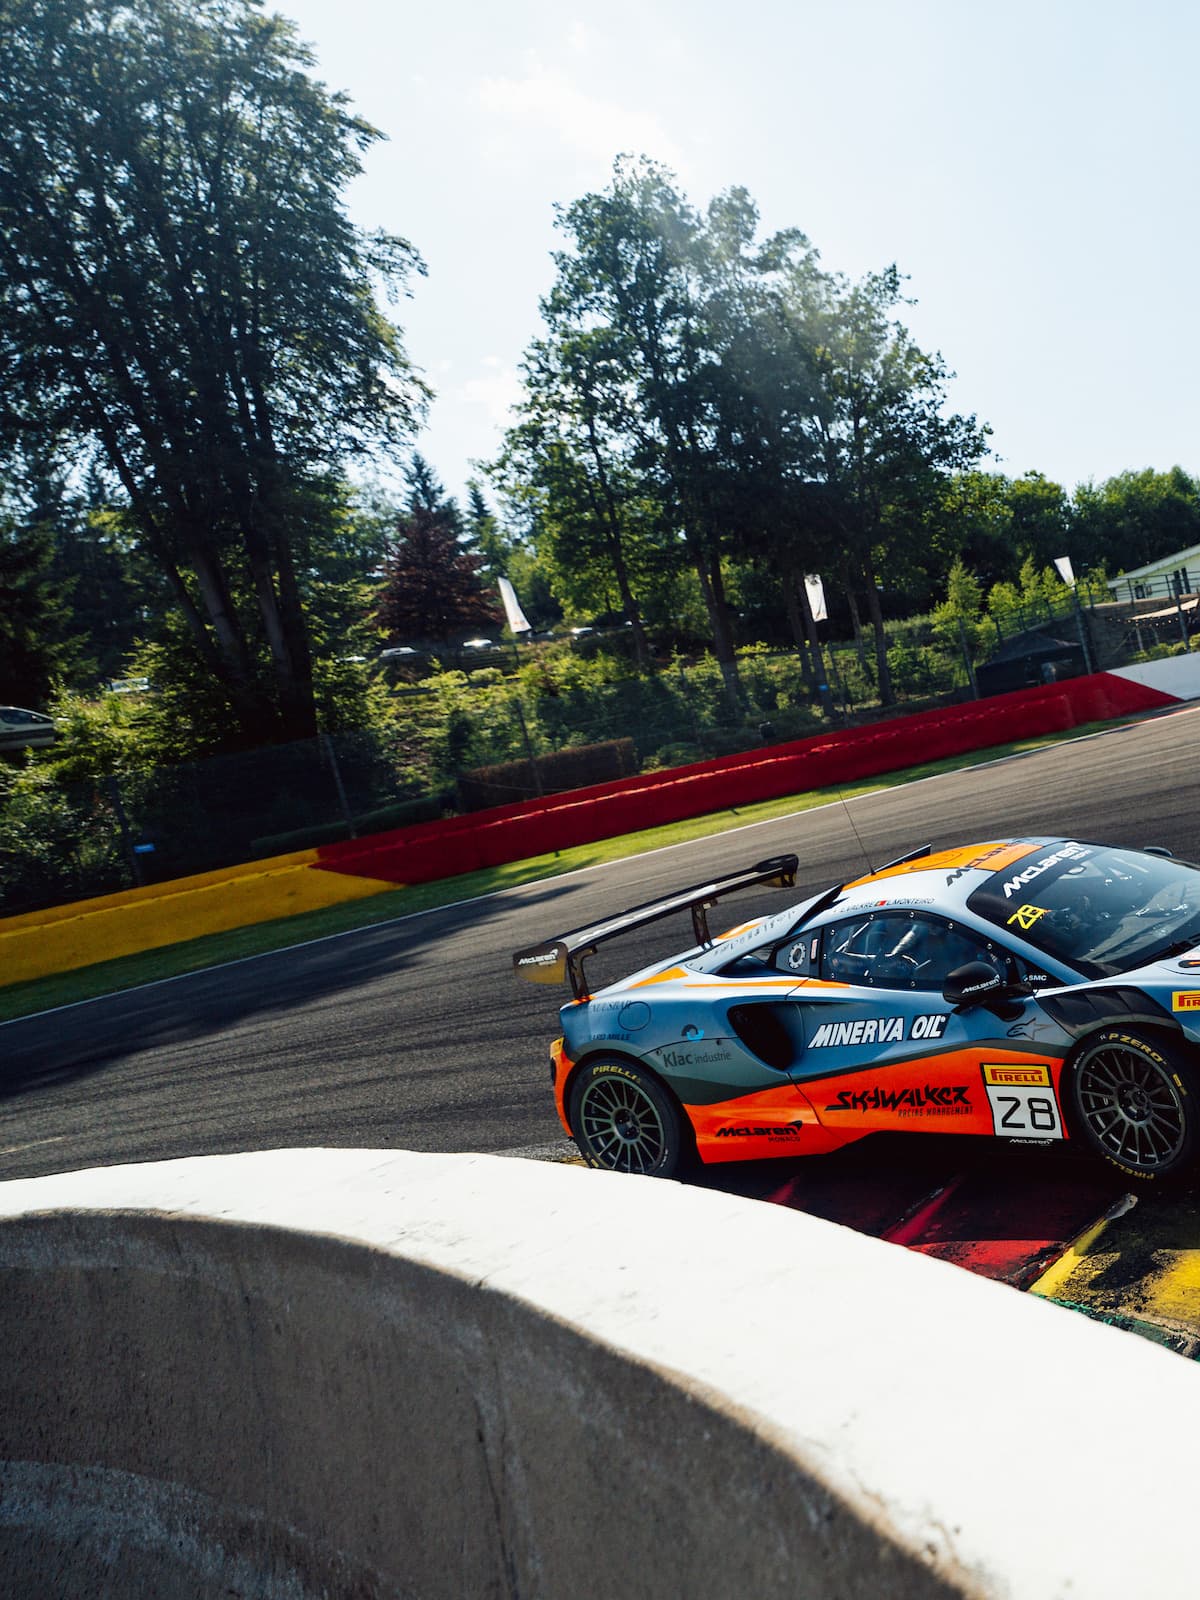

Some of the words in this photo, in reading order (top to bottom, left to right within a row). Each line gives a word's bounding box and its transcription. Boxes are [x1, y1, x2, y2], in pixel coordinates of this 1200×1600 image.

[1003, 844, 1085, 898] McLaren
[1007, 904, 1045, 929] 28
[1029, 974, 1047, 982] SMC
[808, 1016, 904, 1049] MINERVA
[911, 1014, 946, 1038] OIL
[1120, 1034, 1163, 1062] ZERO
[663, 1052, 694, 1068] Klac
[695, 1052, 732, 1064] industrie
[593, 1065, 637, 1080] PIRELLI
[991, 1069, 1043, 1082] PIRELLI
[997, 1096, 1056, 1131] 28
[715, 1124, 801, 1138] McLaren
